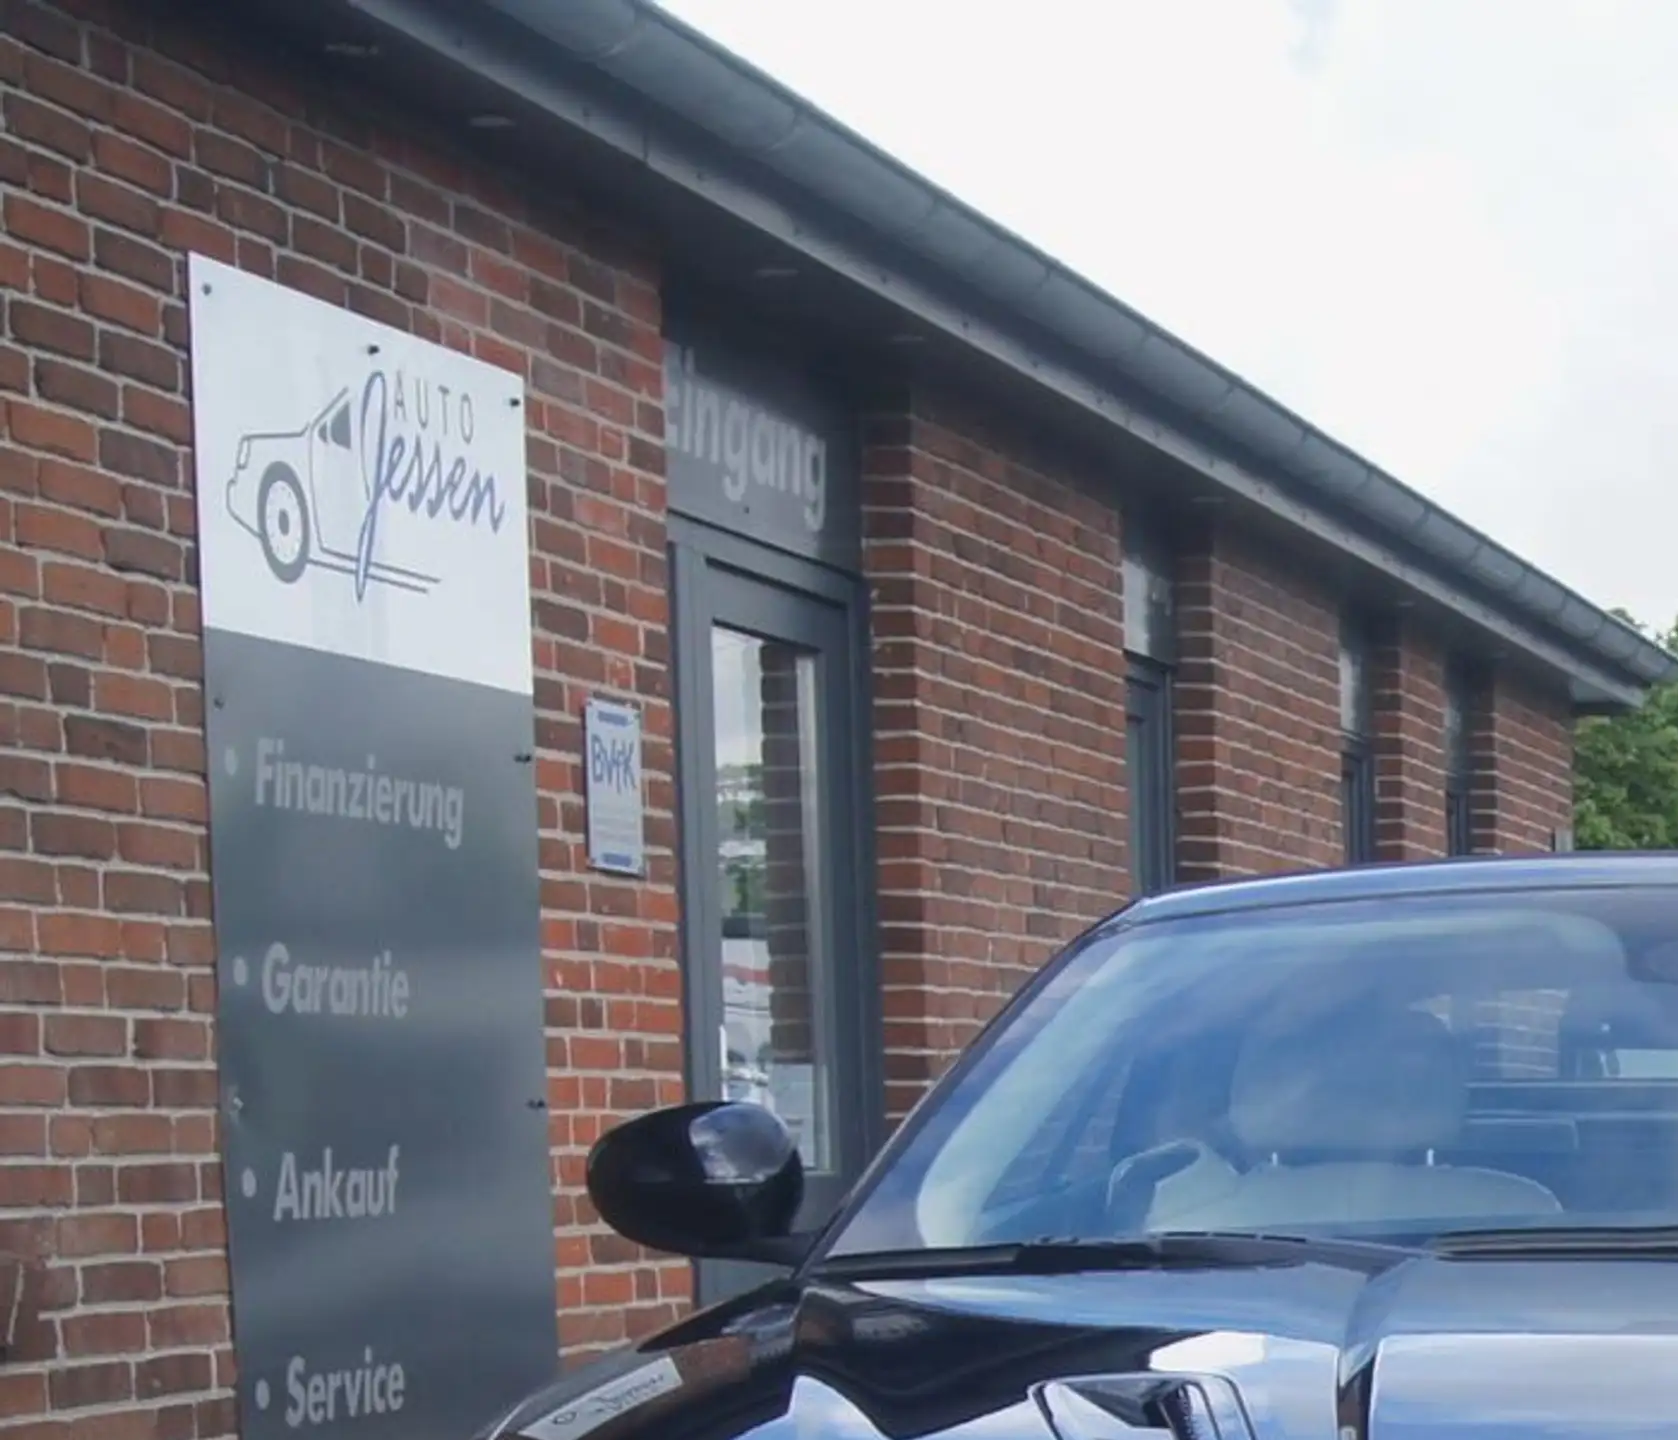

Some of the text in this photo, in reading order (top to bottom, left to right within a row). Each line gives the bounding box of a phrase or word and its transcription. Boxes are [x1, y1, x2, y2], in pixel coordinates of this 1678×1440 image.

[393, 369, 474, 445] AUTO
[355, 370, 505, 602] Jessen
[255, 736, 464, 850] Finanzierung
[261, 939, 410, 1019] Garantie
[272, 1143, 400, 1222] Ankauf
[285, 1344, 406, 1428] Service
